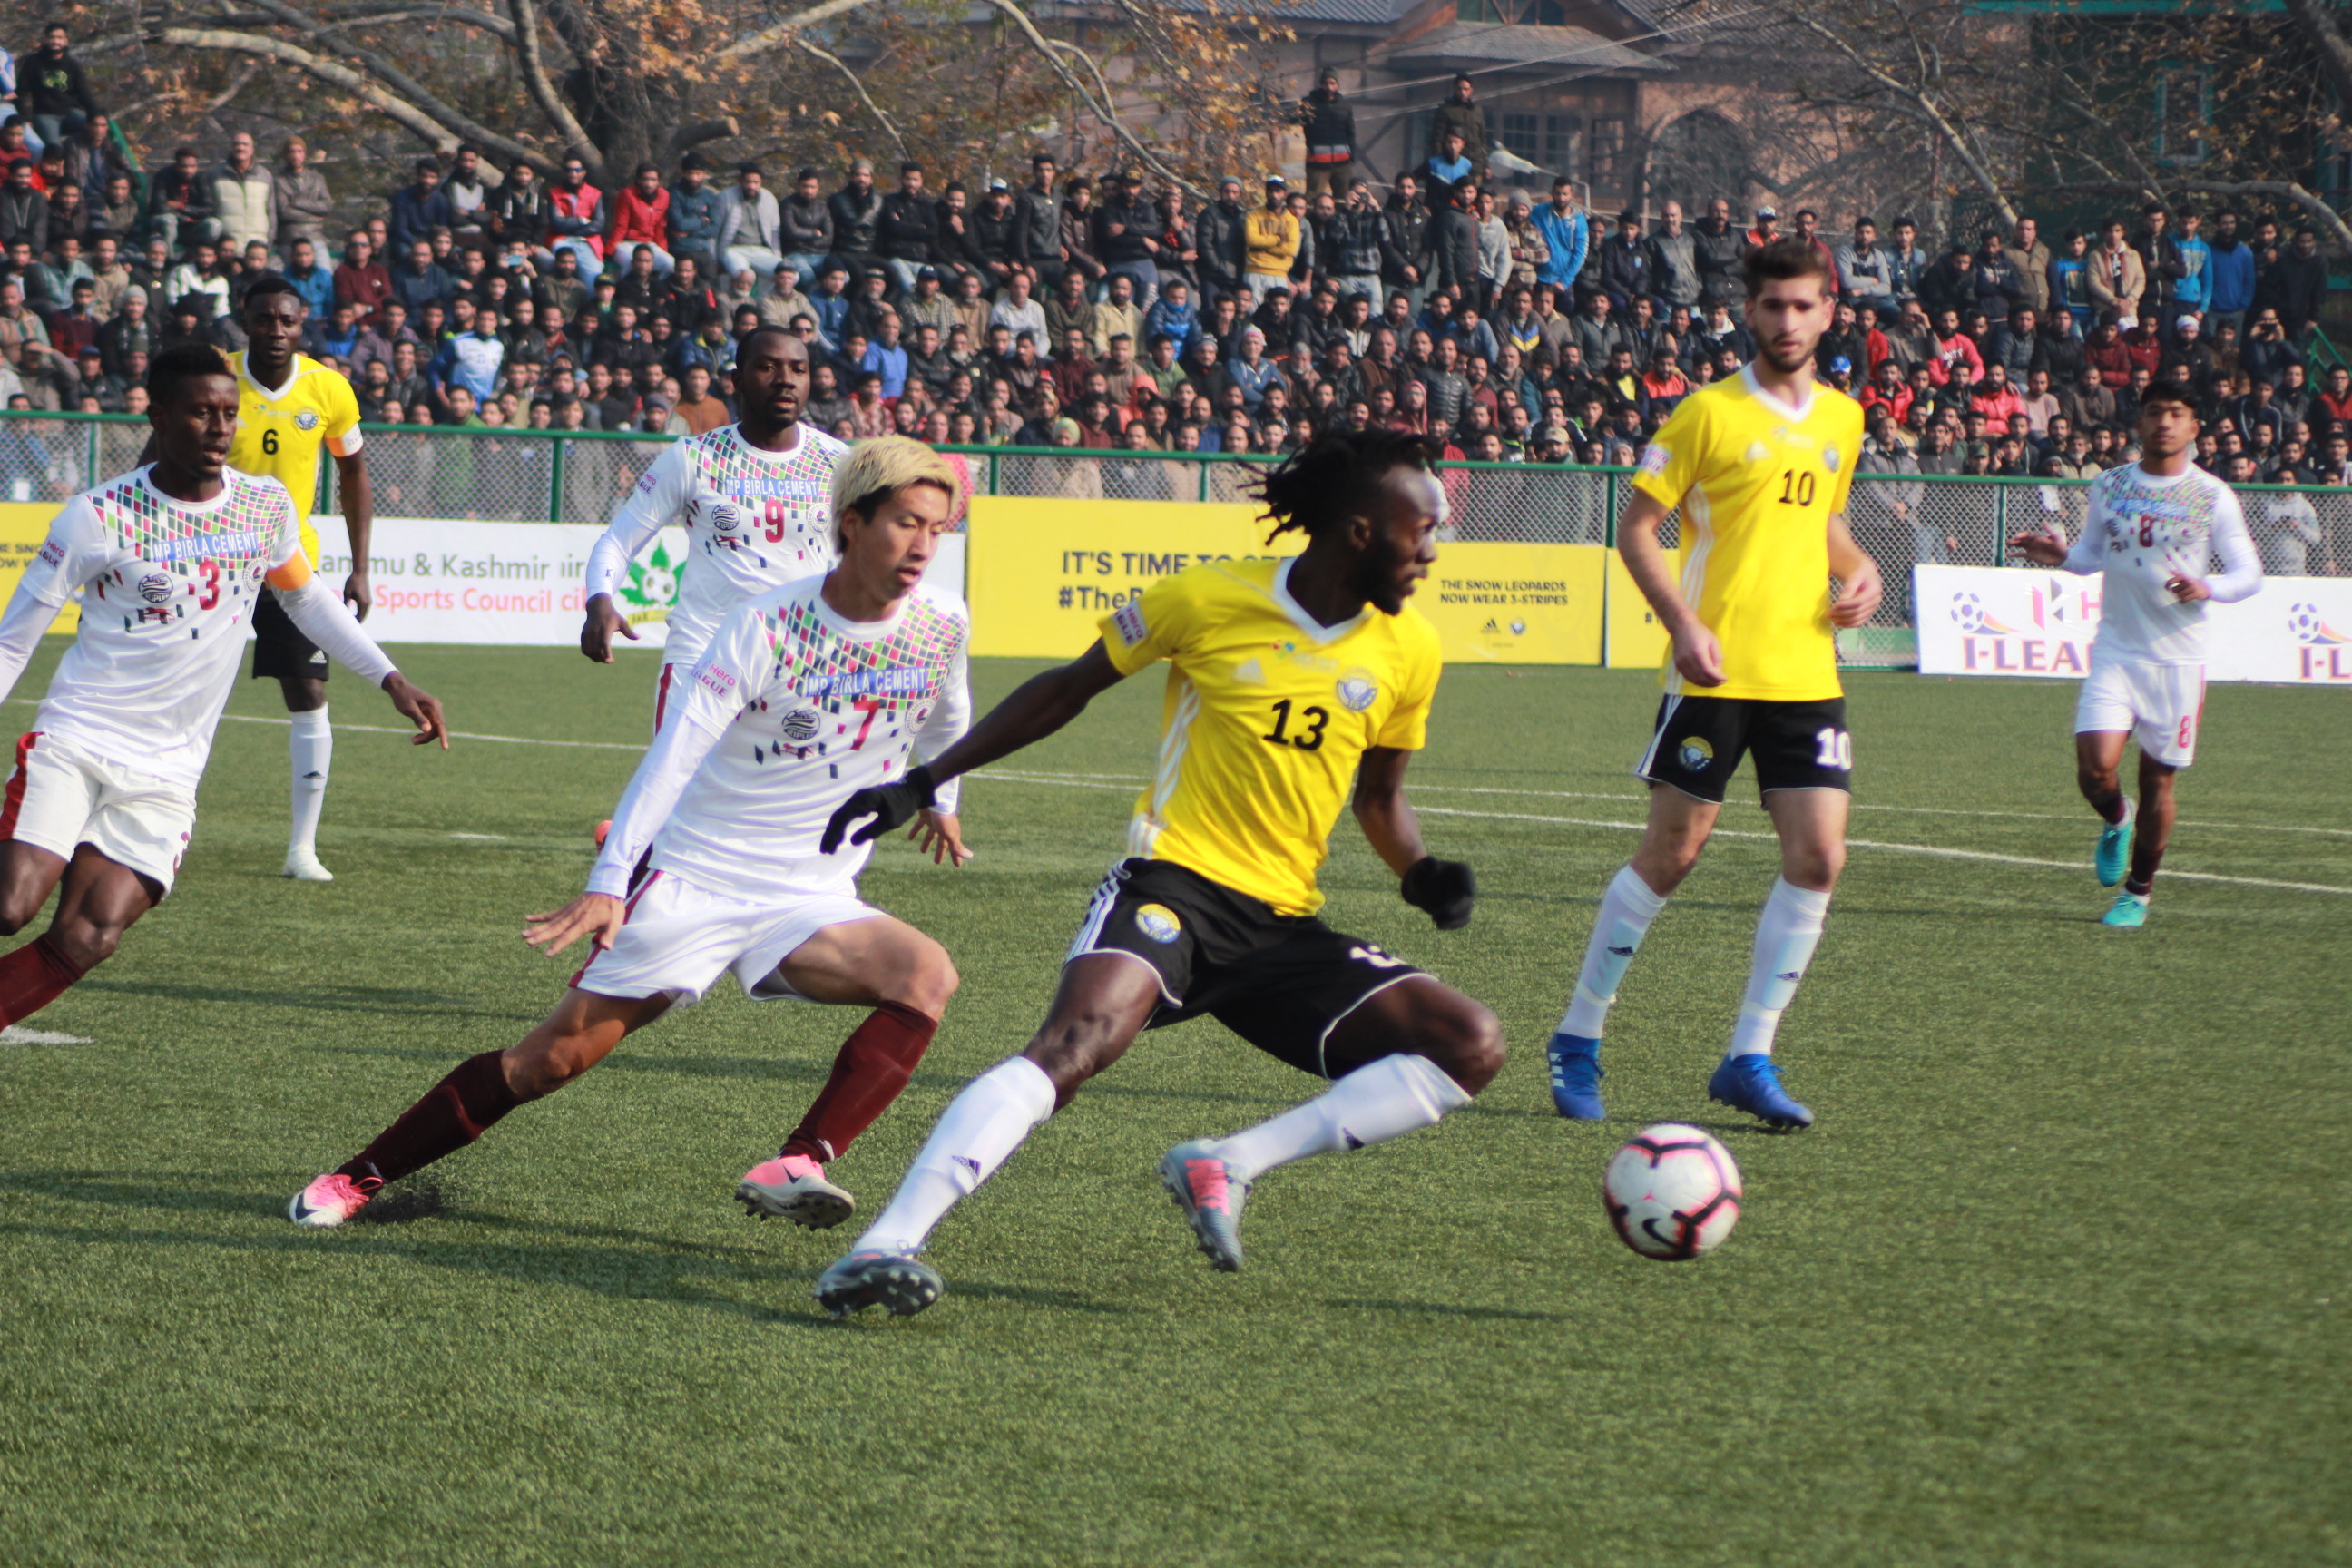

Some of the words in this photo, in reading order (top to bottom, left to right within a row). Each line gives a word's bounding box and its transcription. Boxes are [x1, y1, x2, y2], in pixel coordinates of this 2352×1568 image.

[262, 429, 279, 455] 6
[727, 479, 740, 494] MP
[744, 480, 775, 495] BIRLA
[778, 481, 818, 496] CEMENT
[1779, 469, 1815, 506] 10
[765, 499, 785, 543] 9
[2139, 513, 2153, 548] 8
[154, 543, 171, 559] MP
[174, 536, 209, 557] BIRLA
[212, 532, 257, 553] CEMENT
[414, 553, 433, 576] &
[442, 554, 550, 580] Kashmir
[1063, 551, 1113, 575] IT'S
[199, 561, 220, 610] 3
[1441, 580, 1463, 591] THE
[1466, 580, 1502, 591] SNOW
[1505, 581, 1567, 592] LEOPARDS
[376, 586, 454, 613] Sports
[463, 587, 551, 612] Council
[1441, 594, 1469, 604] NOW
[1473, 594, 1507, 605] WEAR
[1511, 595, 1568, 606] 3-STRIPES
[1962, 636, 2093, 673] I-LEA
[709, 663, 735, 686] Hero
[808, 675, 827, 695] MP
[832, 671, 870, 693] BIRLA
[876, 668, 926, 691] CEMENT
[850, 699, 879, 751] 7
[1262, 699, 1329, 751] 13
[2179, 715, 2191, 748] 8
[1817, 727, 1851, 770] 10
